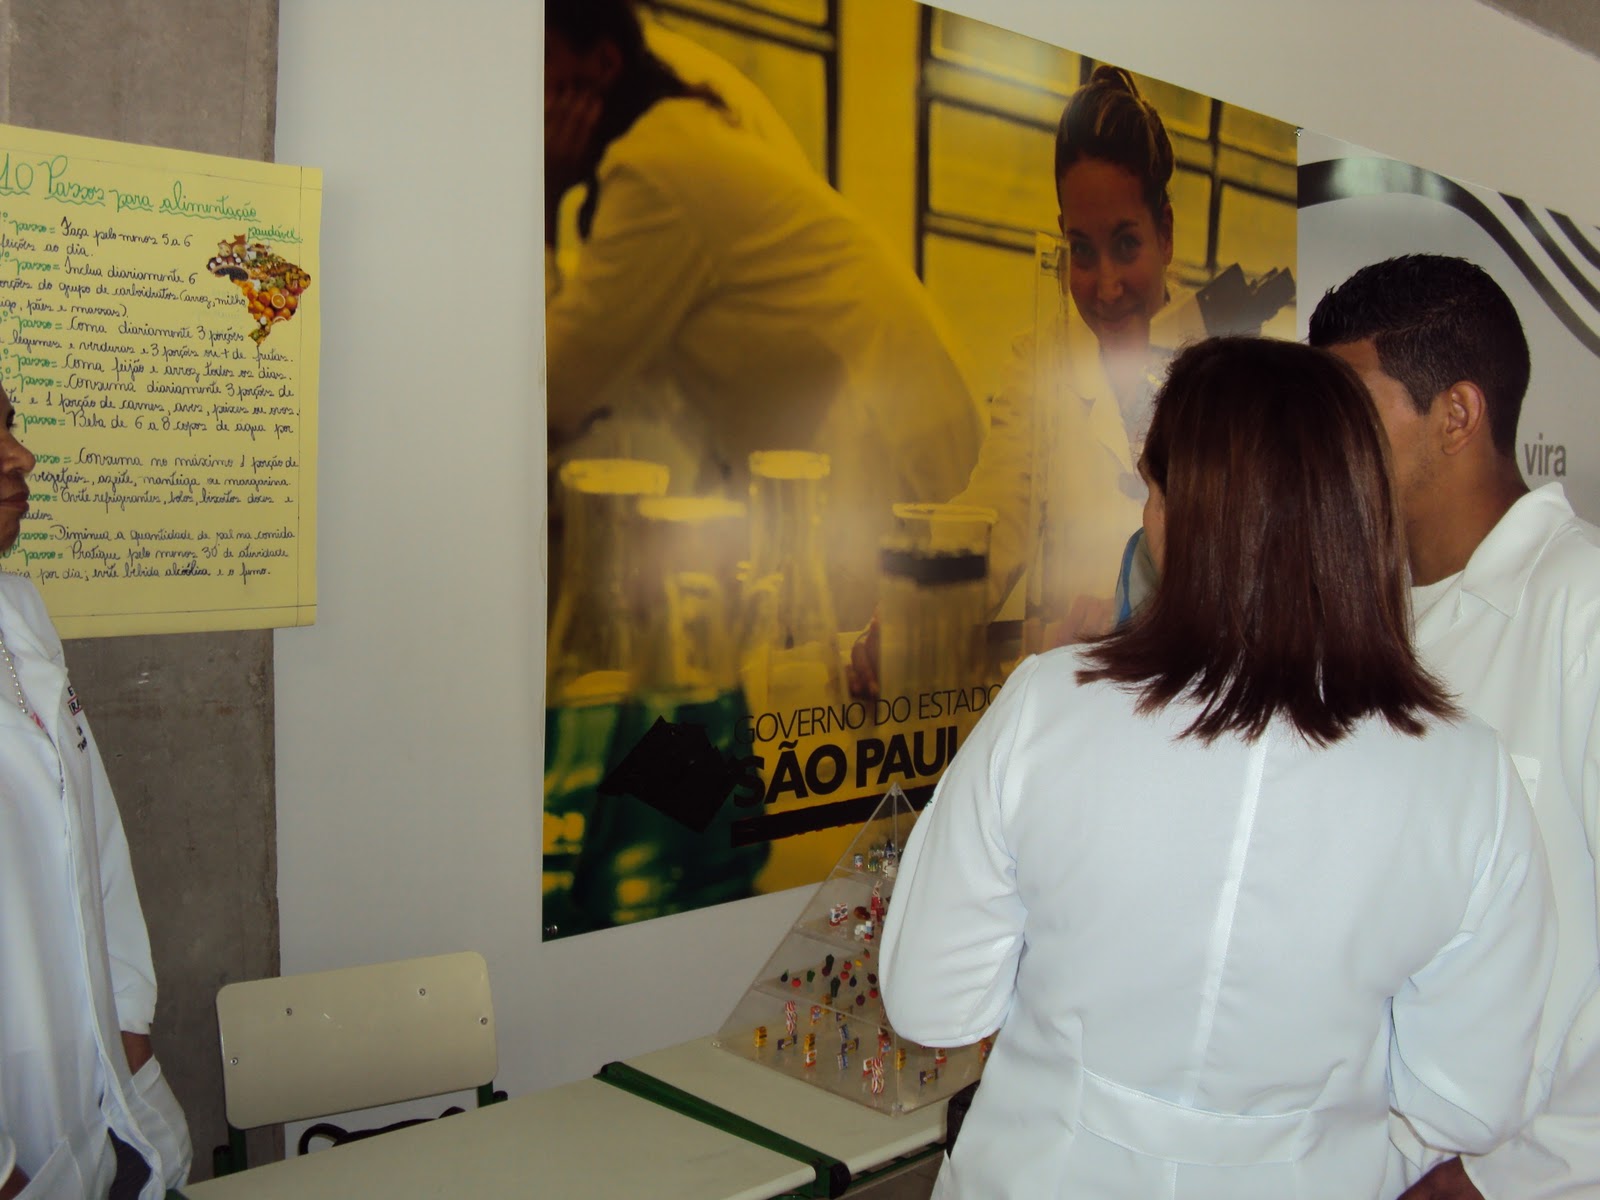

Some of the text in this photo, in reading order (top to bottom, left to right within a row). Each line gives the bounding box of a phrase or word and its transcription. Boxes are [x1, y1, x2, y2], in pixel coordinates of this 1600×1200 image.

[0, 153, 257, 219] 10 Passos para alimentação
[0, 233, 36, 256] feições
[43, 243, 59, 252] ao
[61, 216, 89, 239] Faça
[93, 227, 116, 246] pelo
[118, 233, 158, 244] menos
[162, 233, 169, 246] 5
[171, 238, 180, 246] a
[184, 234, 193, 247] 6
[65, 256, 103, 277] Inclua
[107, 265, 184, 283] diariamente
[188, 273, 198, 285] 6
[0, 278, 32, 290] orções
[38, 279, 53, 289] do
[58, 281, 91, 298] grupo
[96, 284, 109, 295] de
[27, 298, 54, 316] pães
[8, 329, 62, 353] legumes
[79, 341, 136, 354] verduras
[150, 343, 159, 357] 3
[232, 348, 246, 360] de
[66, 315, 107, 333] Coma
[118, 321, 193, 338] diariamente
[197, 326, 206, 340] 3
[209, 327, 244, 347] porções
[61, 353, 105, 373] Coma
[111, 357, 145, 381] feijão
[64, 374, 136, 393] Consuma
[146, 380, 222, 396] diariamente
[226, 383, 235, 397] 3
[278, 384, 294, 398] de
[46, 391, 52, 406] 1
[58, 393, 96, 413] porção
[100, 395, 116, 408] de
[110, 413, 128, 429] de
[134, 415, 145, 430] 6
[161, 416, 171, 431] 8
[216, 420, 230, 432] de
[274, 423, 293, 440] por
[75, 447, 143, 467] Consuma
[151, 457, 168, 468] no
[251, 456, 283, 474] porção
[285, 456, 300, 468] de
[1523, 431, 1567, 477] vira
[142, 470, 201, 494] manteiga
[50, 524, 112, 541] Diminua
[236, 532, 252, 540] na
[254, 527, 296, 540] comida
[66, 540, 121, 567] Pratique
[127, 547, 151, 568] pelo
[223, 547, 234, 558] de
[37, 568, 60, 586] por
[121, 562, 160, 578] bebida
[734, 702, 866, 745] GOVERNO
[873, 696, 911, 727] DO
[733, 739, 848, 807] SÃO
